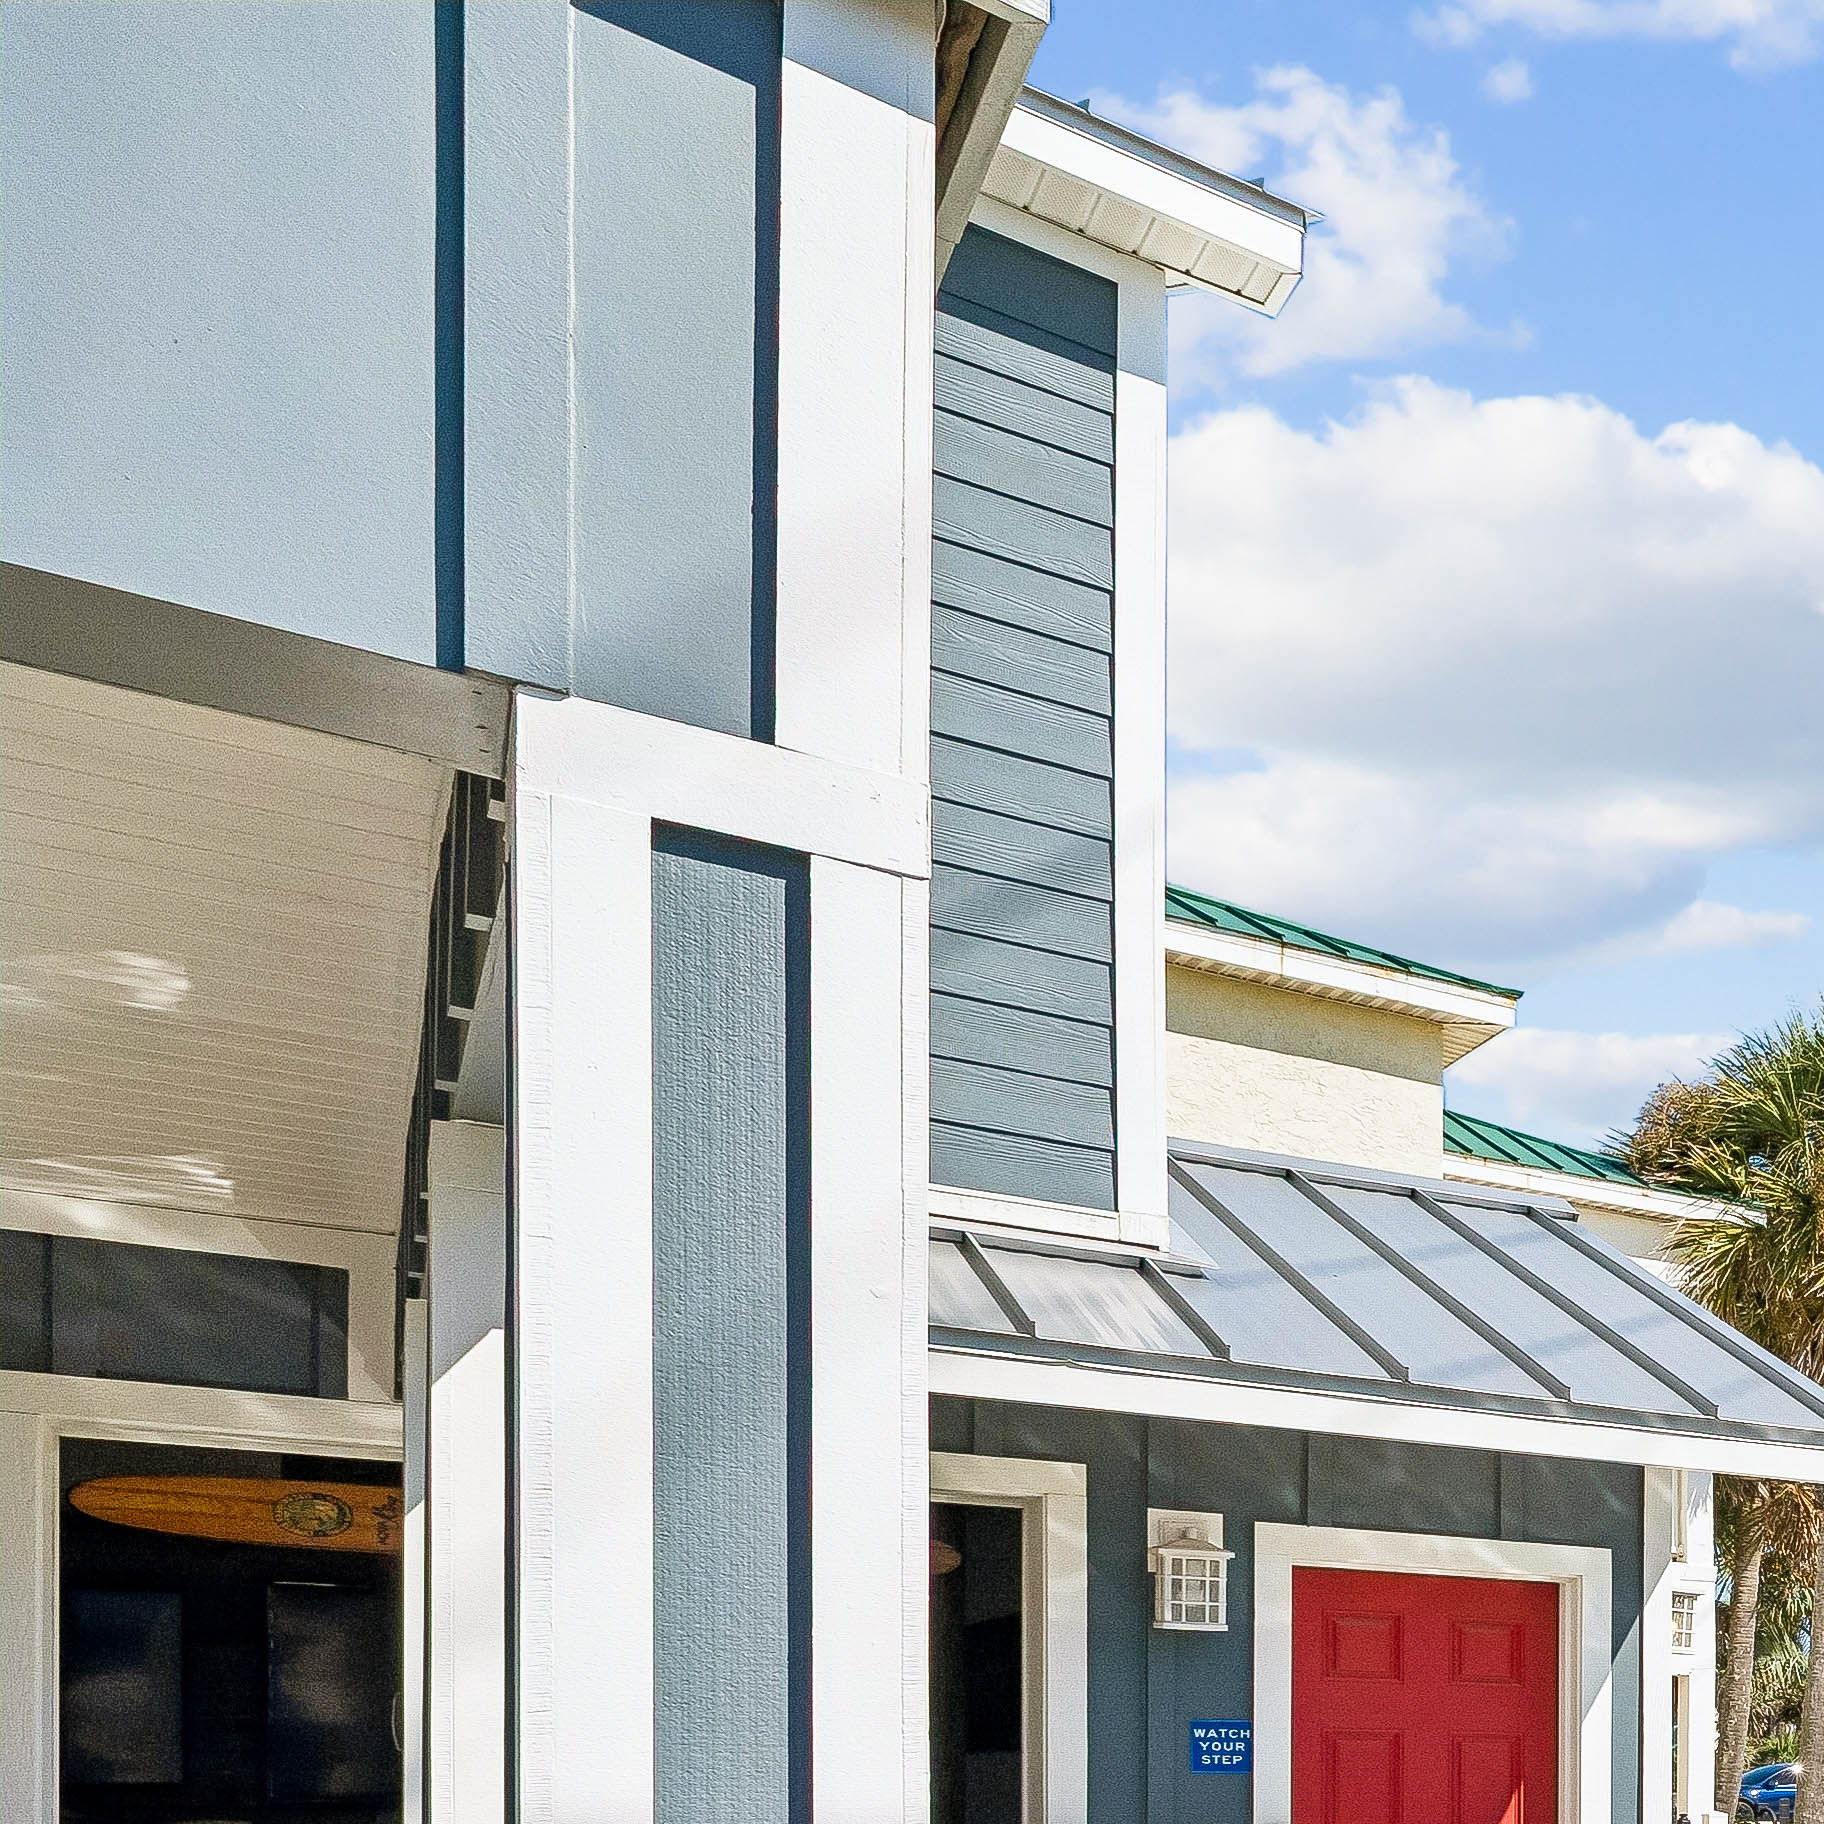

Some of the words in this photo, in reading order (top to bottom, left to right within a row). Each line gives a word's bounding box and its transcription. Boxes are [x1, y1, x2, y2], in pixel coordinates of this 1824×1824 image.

[1193, 1728, 1250, 1739] WATCH
[1199, 1741, 1246, 1752] YOUR
[1201, 1754, 1243, 1765] STEP
